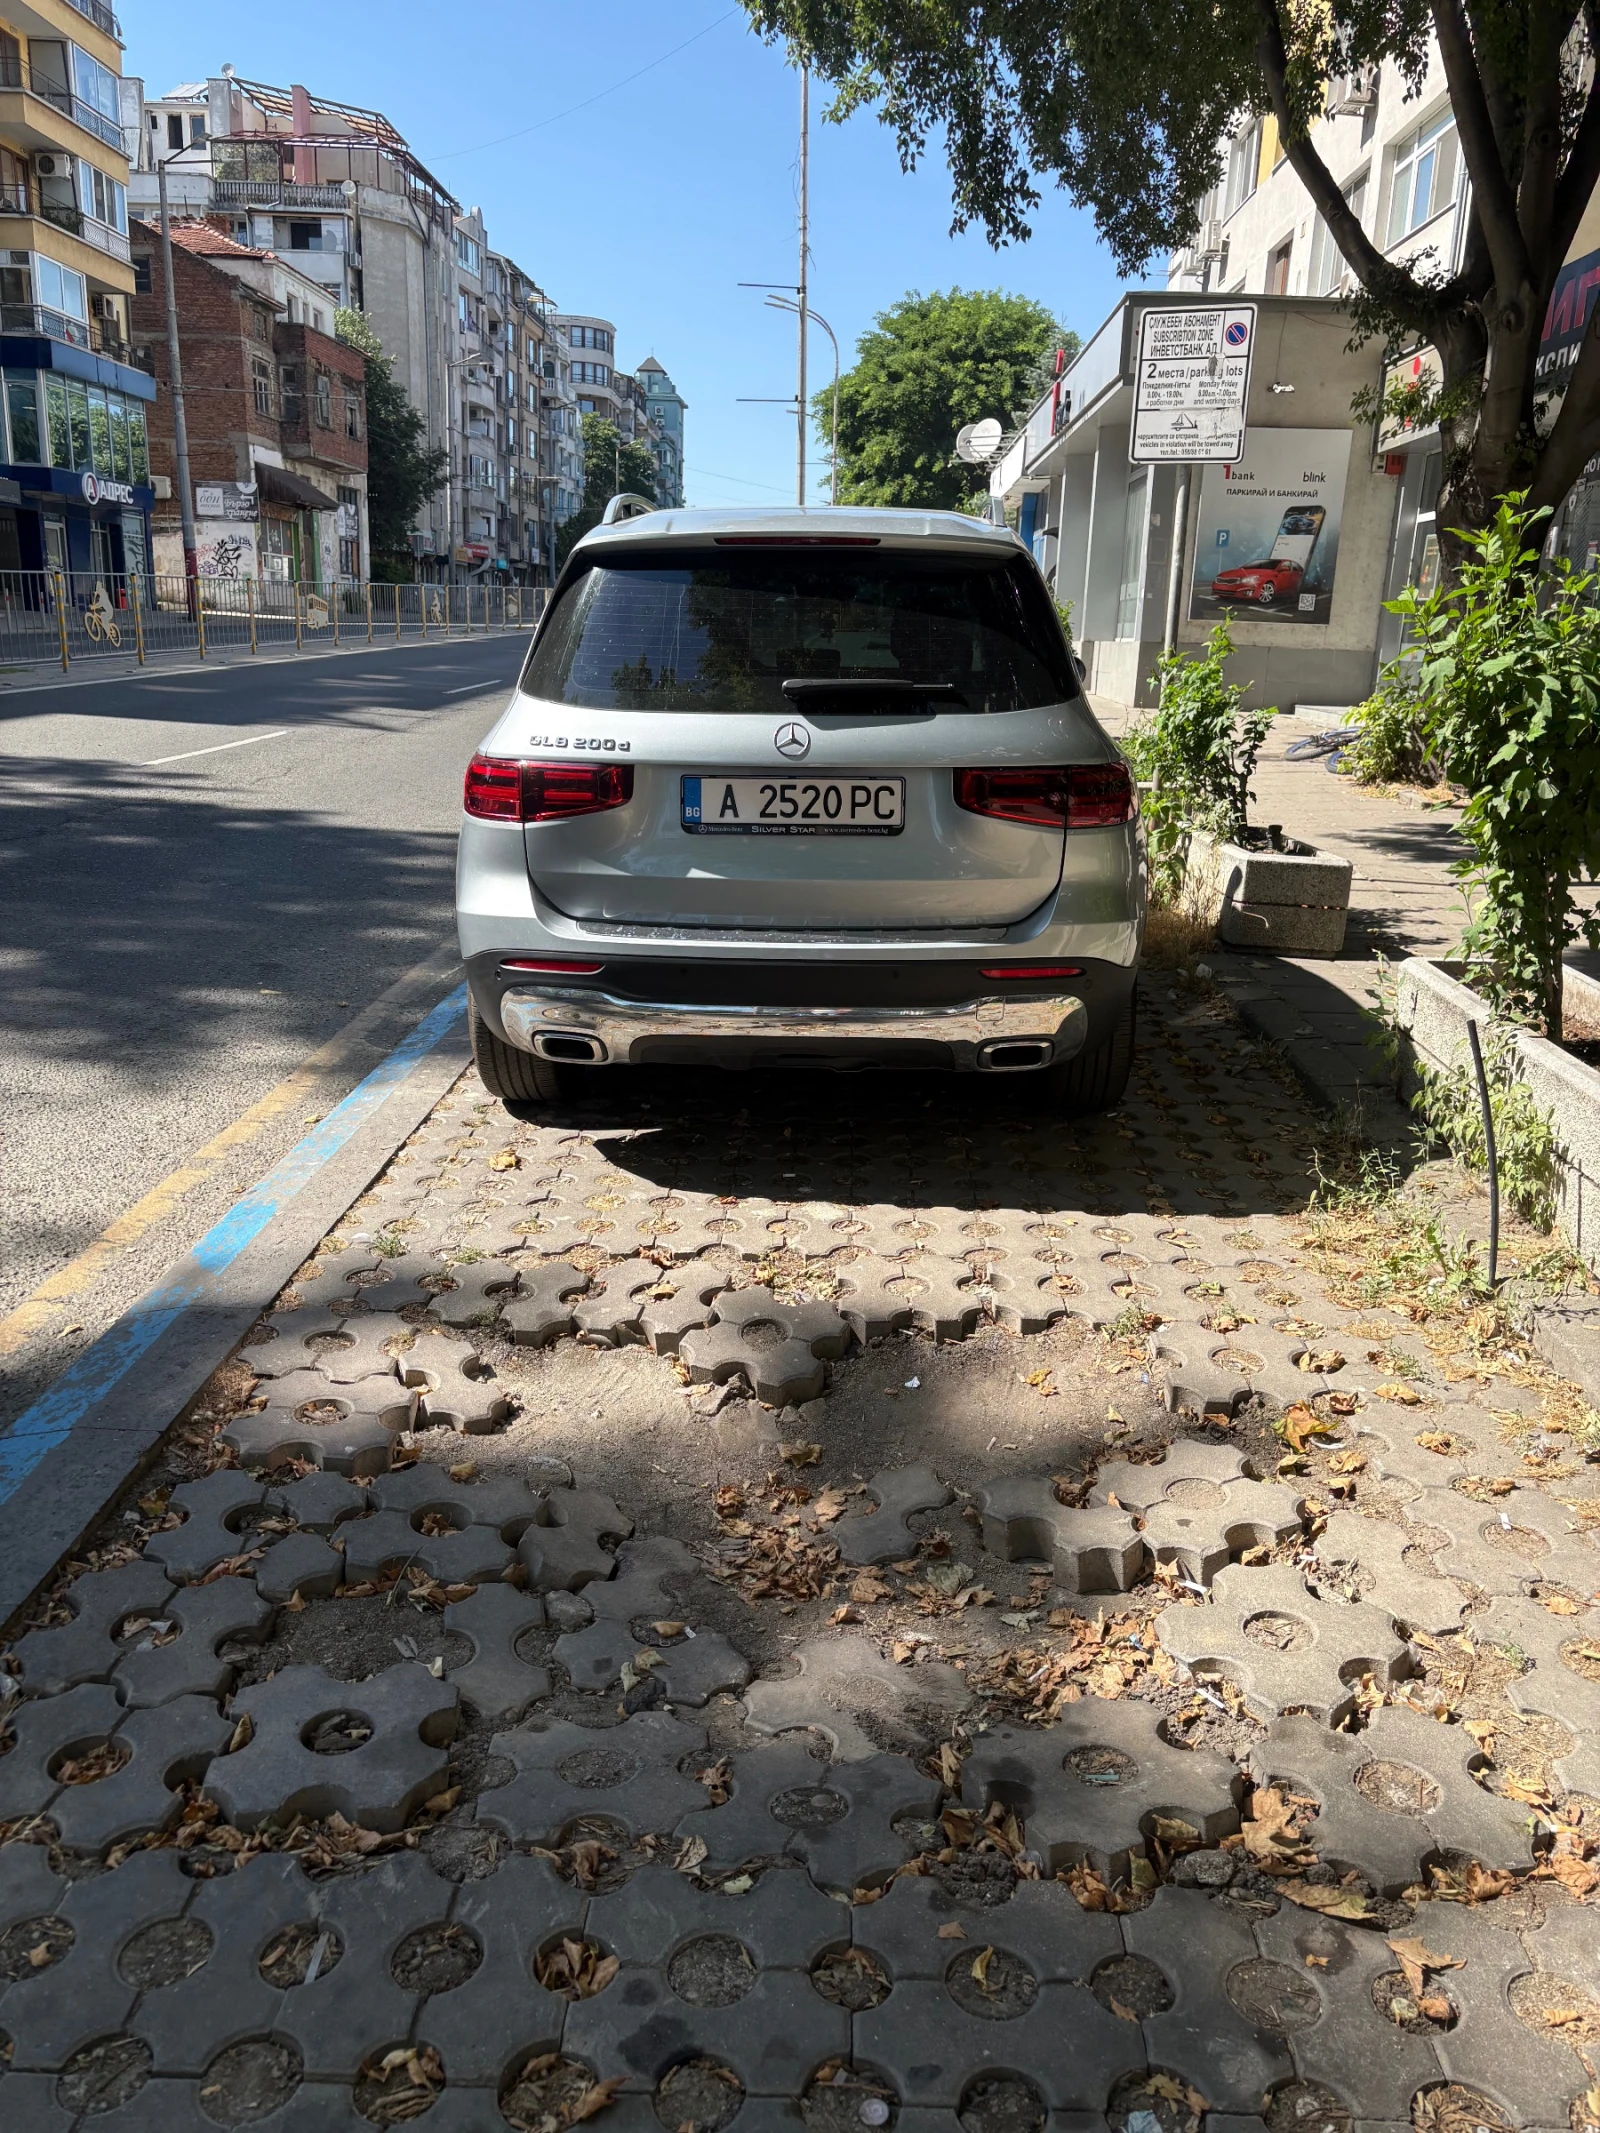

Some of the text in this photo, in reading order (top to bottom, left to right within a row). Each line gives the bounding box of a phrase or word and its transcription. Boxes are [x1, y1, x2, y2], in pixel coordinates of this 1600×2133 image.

[1149, 314, 1222, 328] СЛУЖЕБЕН АБОНАМЕНТ
[1153, 329, 1214, 342] SUBSCRIBTION ZONE
[1206, 342, 1218, 355] АД
[1147, 363, 1157, 378] 2
[1158, 369, 1184, 378] места
[1226, 365, 1243, 376] lots
[1303, 472, 1326, 482] blink
[99, 480, 134, 504] АДРЕС
[1226, 488, 1268, 496] ПАРКИРАЙ
[1219, 532, 1227, 545] P
[530, 736, 630, 752] GLB 200d
[719, 784, 895, 820] A 2520 PC
[686, 807, 700, 817] BG
